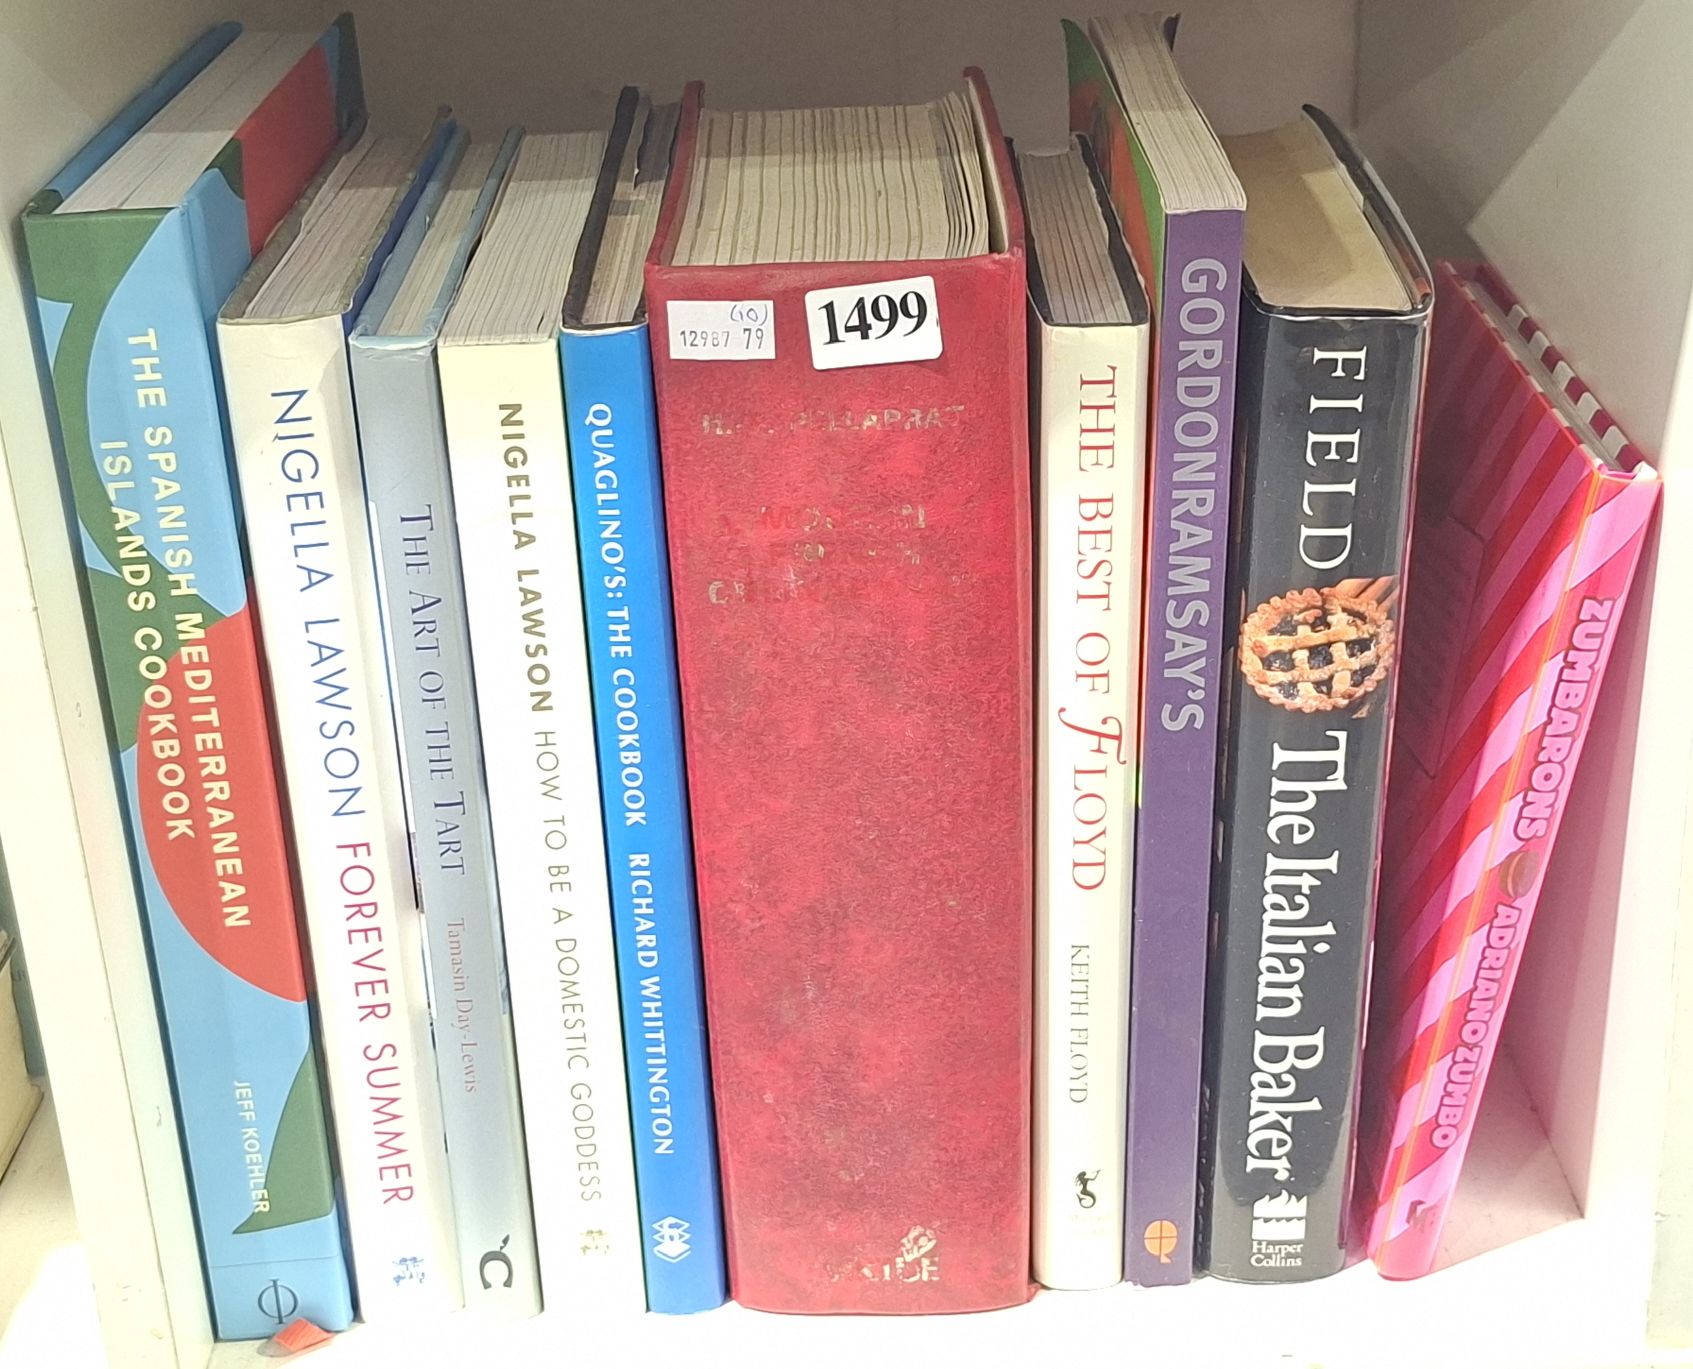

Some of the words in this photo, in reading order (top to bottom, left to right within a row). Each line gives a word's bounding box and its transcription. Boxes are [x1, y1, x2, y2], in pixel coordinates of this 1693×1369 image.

[127, 327, 167, 409] THE
[679, 329, 730, 348] 12987
[743, 328, 764, 350] 79
[817, 291, 928, 346] 1499
[498, 403, 536, 550] NIGELLA
[1079, 364, 1118, 473] THE
[1297, 346, 1368, 571] FIELD
[144, 426, 198, 597] SPANISH
[271, 389, 334, 594] NIGELLA
[585, 402, 628, 599] QUAGLINO'S:
[1075, 493, 1115, 612] BEST
[100, 441, 156, 612] ISLANDS
[134, 627, 195, 841] COOKBOOK
[517, 568, 553, 712] LAWSON
[606, 606, 632, 658] THE
[1075, 632, 1111, 695] OF
[174, 612, 251, 929] MEDITERRANEAN
[304, 617, 365, 818] LAWSON
[533, 731, 564, 801] HOW
[611, 668, 647, 827] COOKBOOK
[1513, 598, 1614, 841] ZUMBARONS
[541, 815, 567, 850] TO
[1058, 706, 1127, 892] FLOYD
[1265, 730, 1348, 846] The
[335, 842, 392, 1024] FOREVER
[548, 865, 572, 894] BE
[552, 907, 574, 925] A
[628, 853, 660, 968] RICHARD
[1257, 849, 1340, 1023] Italian
[447, 918, 470, 992] Tamasin
[555, 937, 590, 1070] DOMESTIC
[1069, 943, 1090, 1017] KEITH
[1459, 903, 1522, 1045] ADRIANO
[233, 1081, 256, 1121] JEFF
[361, 1043, 415, 1206] SUMMER
[640, 975, 674, 1156] WHITTINGTON
[1069, 1027, 1090, 1105] FLOYD
[1246, 1026, 1326, 1190] Baker
[1429, 1045, 1482, 1149] ZUMBO
[241, 1127, 271, 1213] KOEHLER
[569, 1083, 602, 1202] GODDESS
[1250, 1254, 1303, 1268] Collins
[1251, 1241, 1304, 1255] Harper
